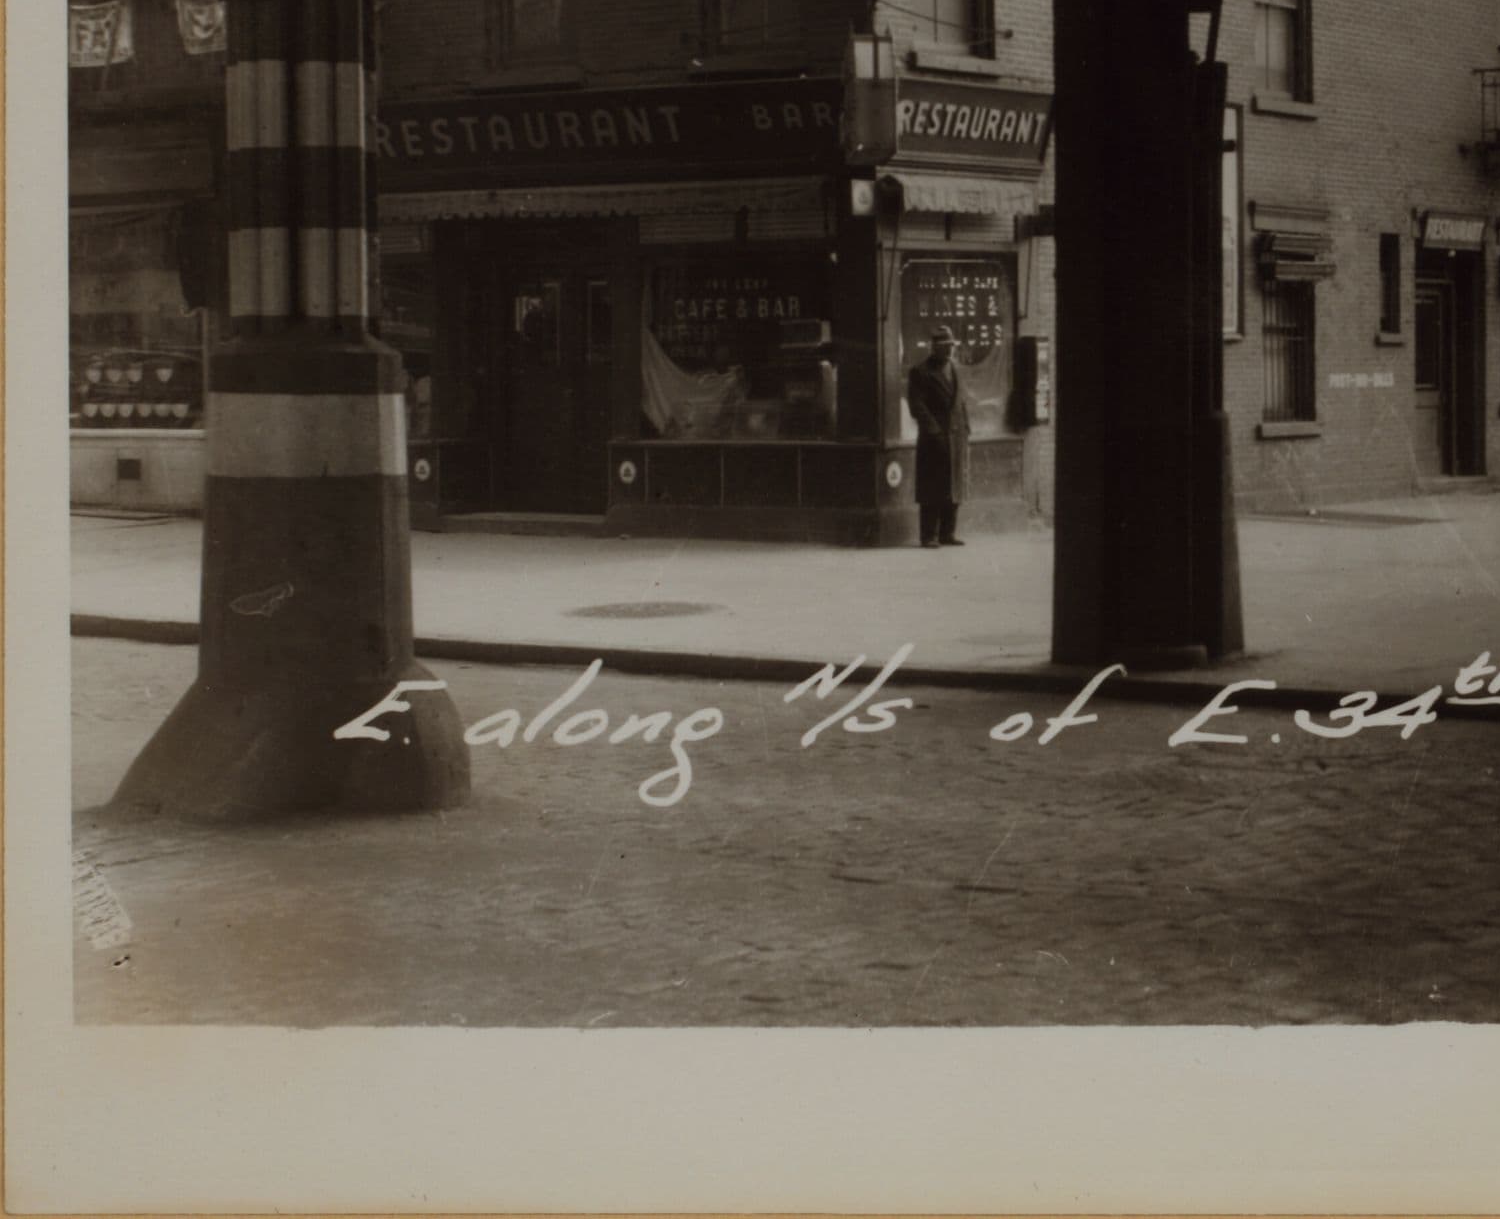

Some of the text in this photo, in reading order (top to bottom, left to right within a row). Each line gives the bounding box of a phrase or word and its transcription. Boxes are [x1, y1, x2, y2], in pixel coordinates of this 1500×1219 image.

[375, 100, 836, 158] RESTAURANT BAR
[897, 98, 1047, 144] RESTAURANT
[674, 296, 800, 319] CAFE & BAR
